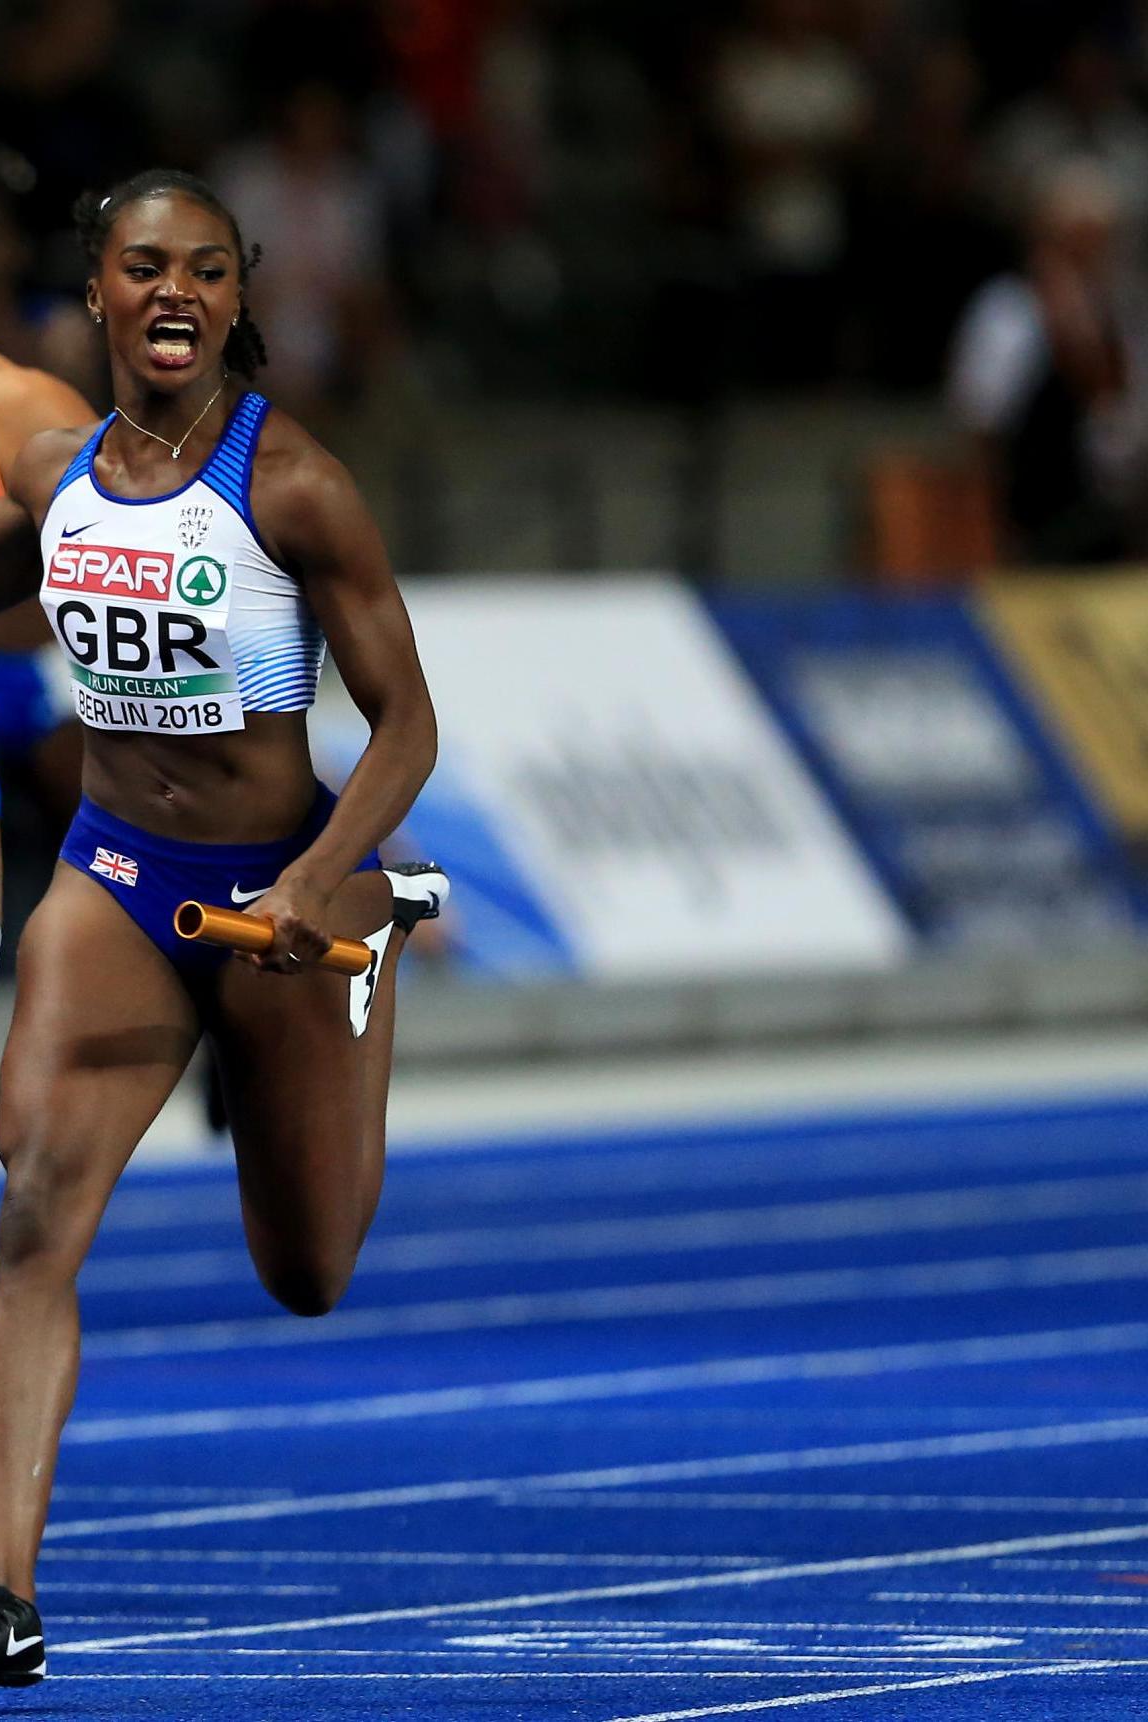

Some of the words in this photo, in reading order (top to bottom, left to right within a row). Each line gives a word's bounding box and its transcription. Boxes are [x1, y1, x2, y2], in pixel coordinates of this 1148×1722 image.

[51, 549, 170, 594] SPAR
[56, 600, 220, 673] GBR
[92, 674, 121, 693] RUN
[78, 689, 149, 727] BERLIN
[154, 701, 223, 729] 2018
